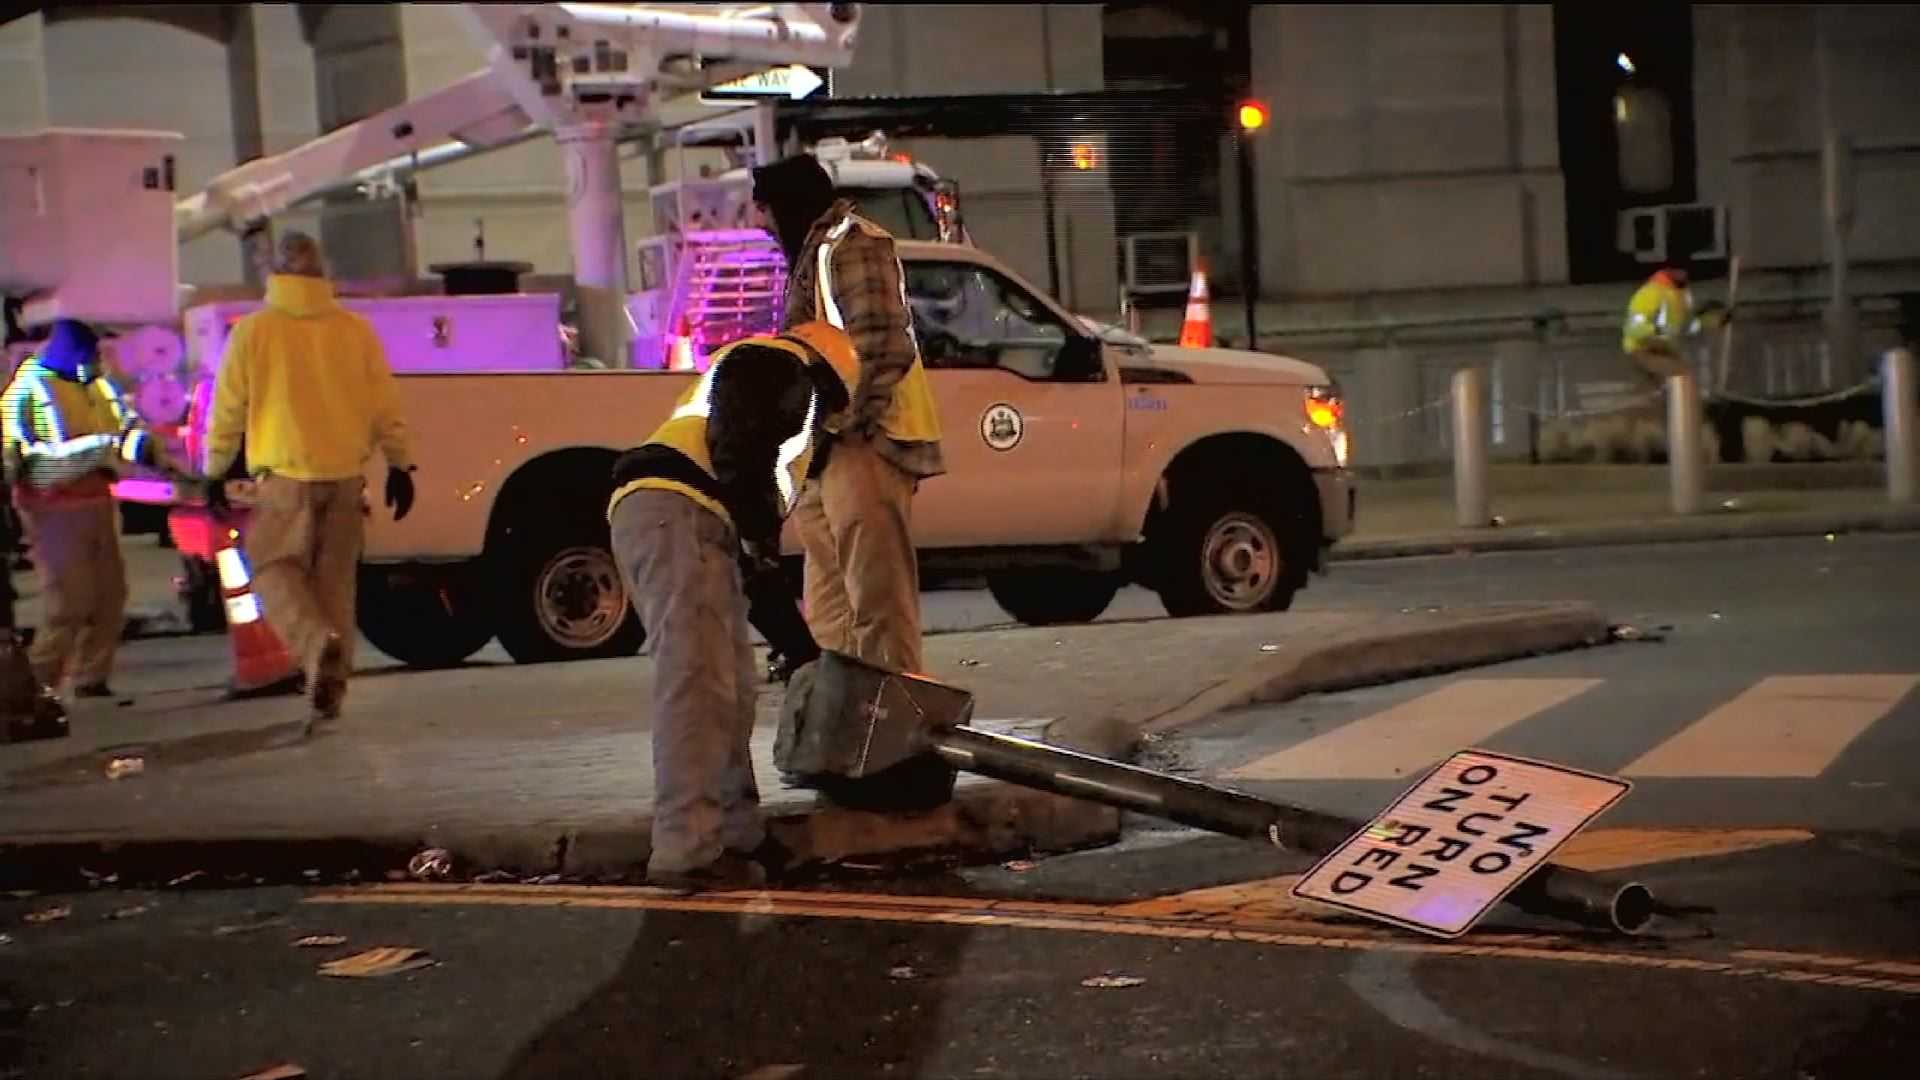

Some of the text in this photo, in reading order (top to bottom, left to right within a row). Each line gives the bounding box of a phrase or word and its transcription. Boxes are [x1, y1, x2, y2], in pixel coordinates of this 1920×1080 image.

[757, 71, 790, 87] WAY
[1331, 765, 1497, 895] ON RED
[1390, 793, 1530, 890] TURN
[1469, 822, 1548, 874] NO
